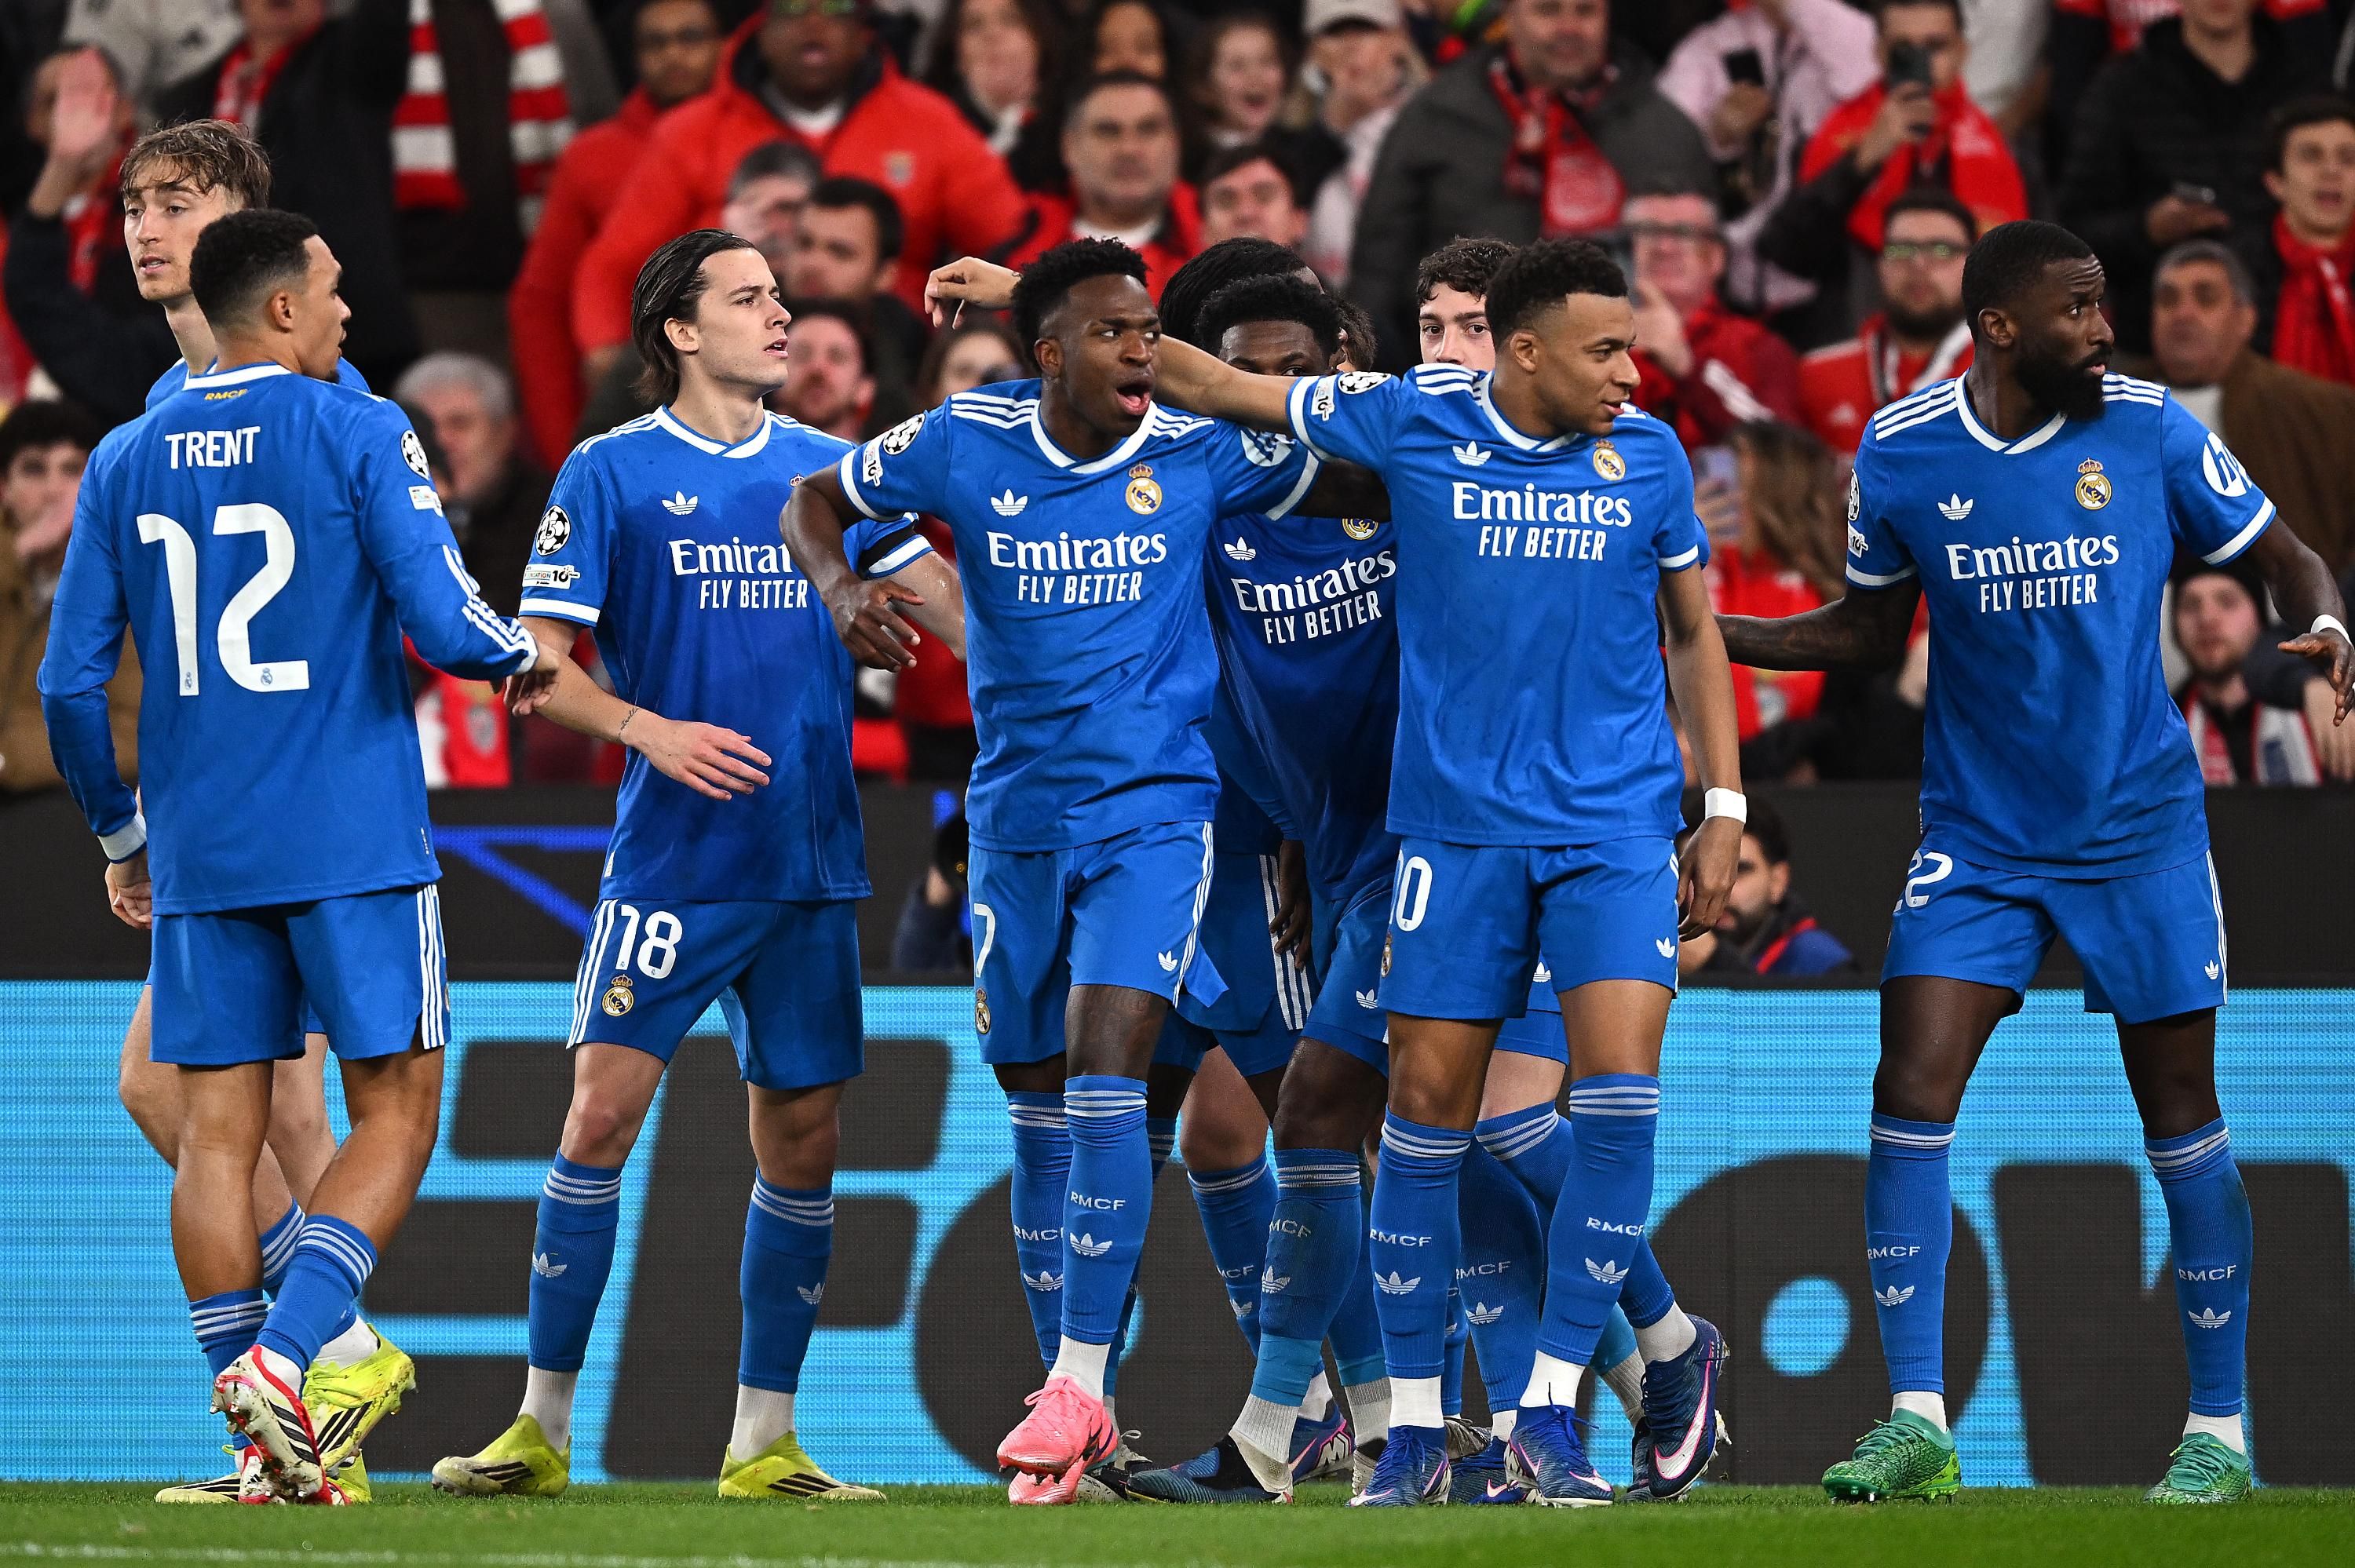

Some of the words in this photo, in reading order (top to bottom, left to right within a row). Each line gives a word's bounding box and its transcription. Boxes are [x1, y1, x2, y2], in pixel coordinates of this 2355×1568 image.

[204, 388, 248, 400] RMCF
[165, 426, 261, 469] TRENT
[1453, 483, 1632, 527] Emirates
[668, 536, 794, 576] Emirat
[986, 531, 1167, 571] Emirates
[1478, 526, 1522, 557] FLY
[1524, 527, 1606, 561] BETTER
[1945, 535, 2120, 580] Emirates
[137, 503, 309, 695] 12
[699, 579, 732, 610] FLY
[740, 579, 809, 609] BETTER
[1018, 575, 1055, 603] FLY
[1063, 571, 1143, 604] BETTER
[1231, 551, 1397, 612] Emirates
[1981, 581, 2014, 613] FLY
[2022, 573, 2098, 609] BETTER
[1264, 615, 1295, 644] FLY
[1305, 591, 1382, 639] BETTER
[615, 903, 683, 979] 18
[973, 903, 995, 978] 7
[1071, 1191, 1126, 1210] RMCF
[1013, 1224, 1064, 1241] RMC
[1269, 1219, 1311, 1238] MCF
[1370, 1228, 1432, 1247] RMCF
[1216, 1265, 1254, 1278] MCF
[1868, 1246, 1920, 1260] RMCF
[2178, 1265, 2236, 1281] RMCF
